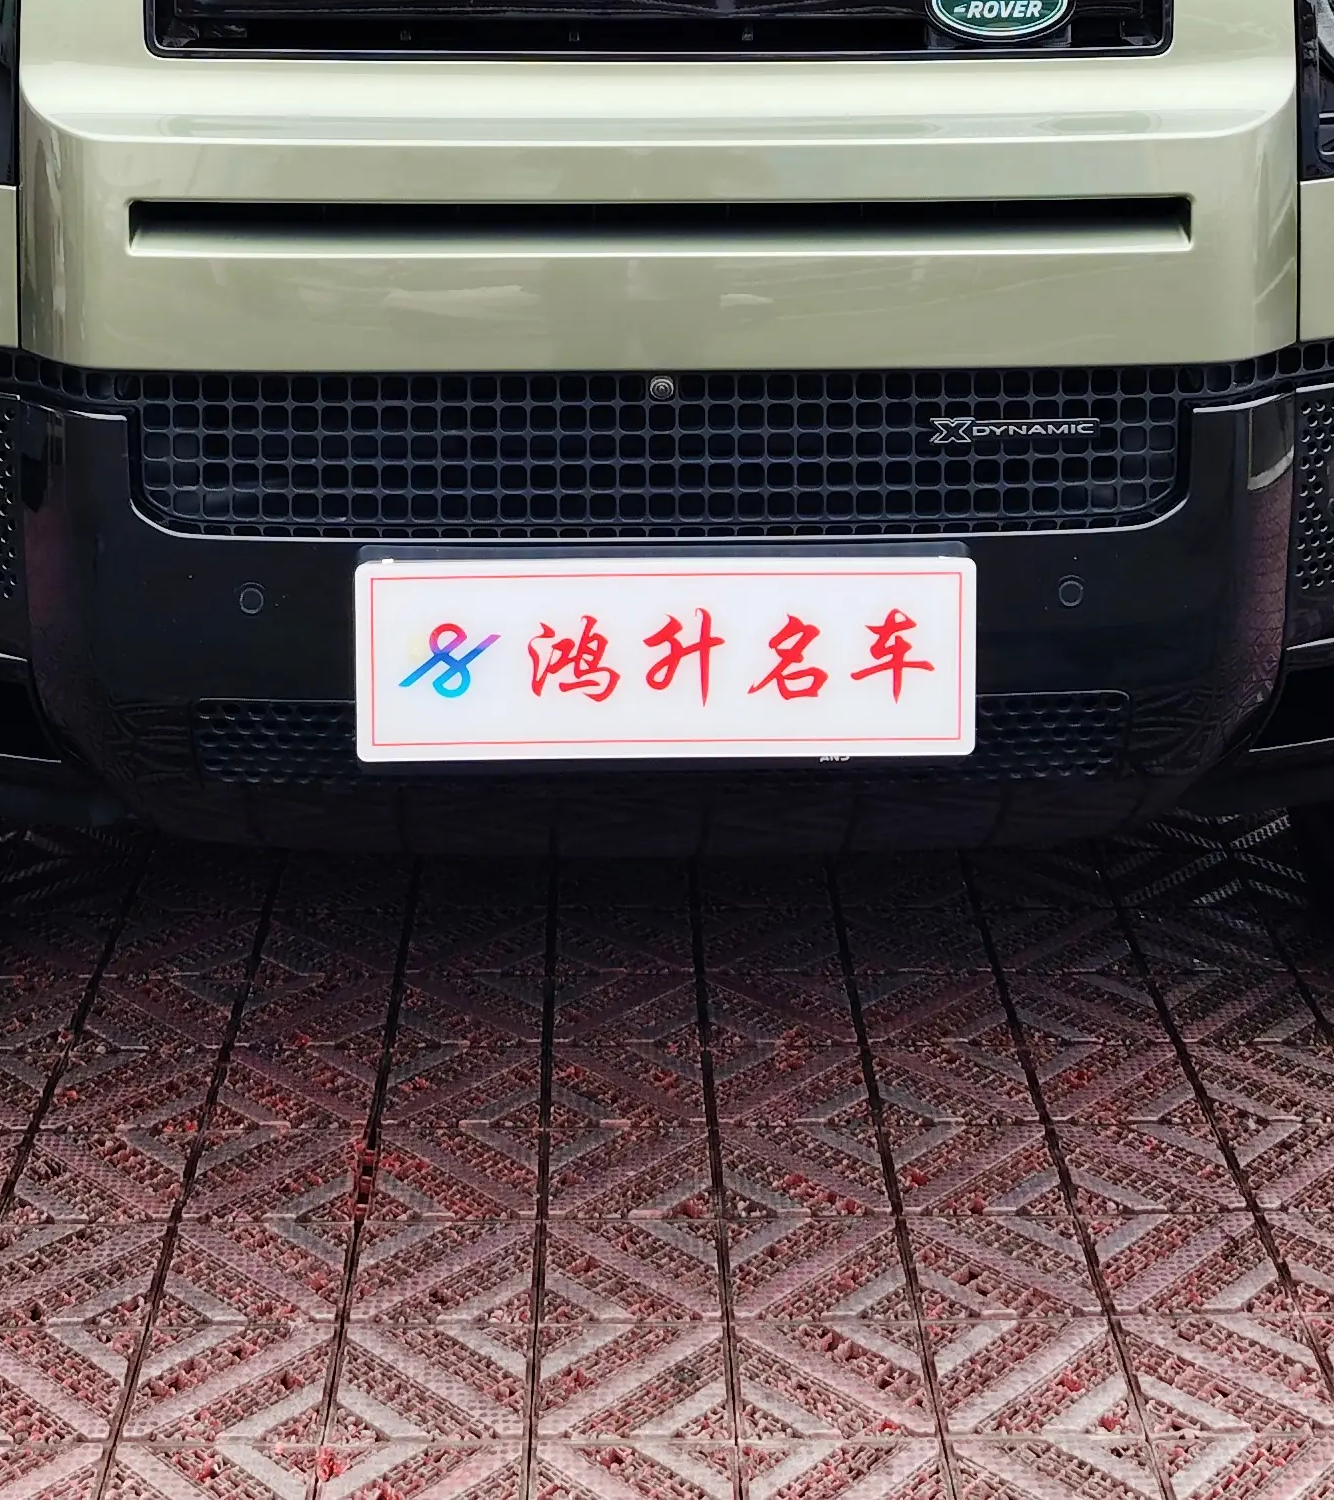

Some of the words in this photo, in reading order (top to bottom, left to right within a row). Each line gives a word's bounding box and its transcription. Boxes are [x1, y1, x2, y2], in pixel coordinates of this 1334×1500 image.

[967, 0, 1043, 19] ROVER
[528, 608, 935, 704] 鸿升名车
